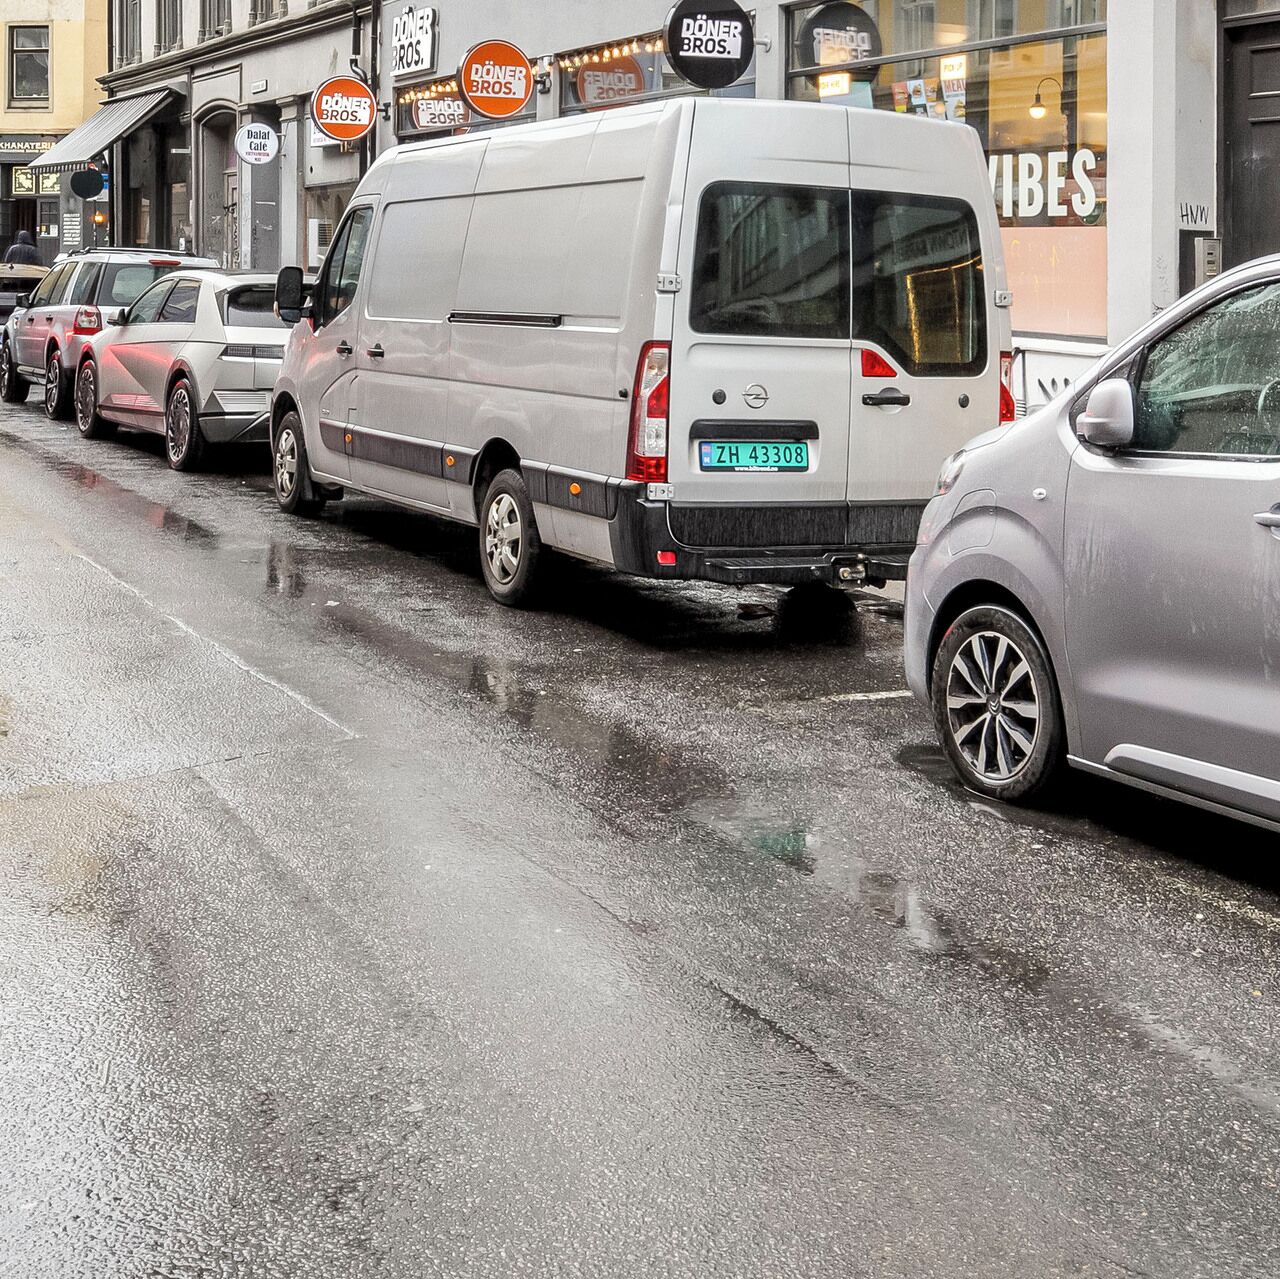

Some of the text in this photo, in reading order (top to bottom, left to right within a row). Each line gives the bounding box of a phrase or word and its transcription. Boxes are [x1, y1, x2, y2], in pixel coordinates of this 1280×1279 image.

[392, 5, 434, 42] DÖNER
[681, 14, 743, 39] DÖNER
[391, 39, 425, 70] BROS.
[681, 37, 732, 55] BROS.
[470, 60, 525, 81] DÖNER
[470, 79, 517, 97] BROS.
[322, 92, 371, 112] DÖNER
[321, 108, 362, 122] BROS.
[247, 130, 270, 140] Dalat
[249, 141, 268, 151] Café
[716, 445, 804, 464] ZH 43308
